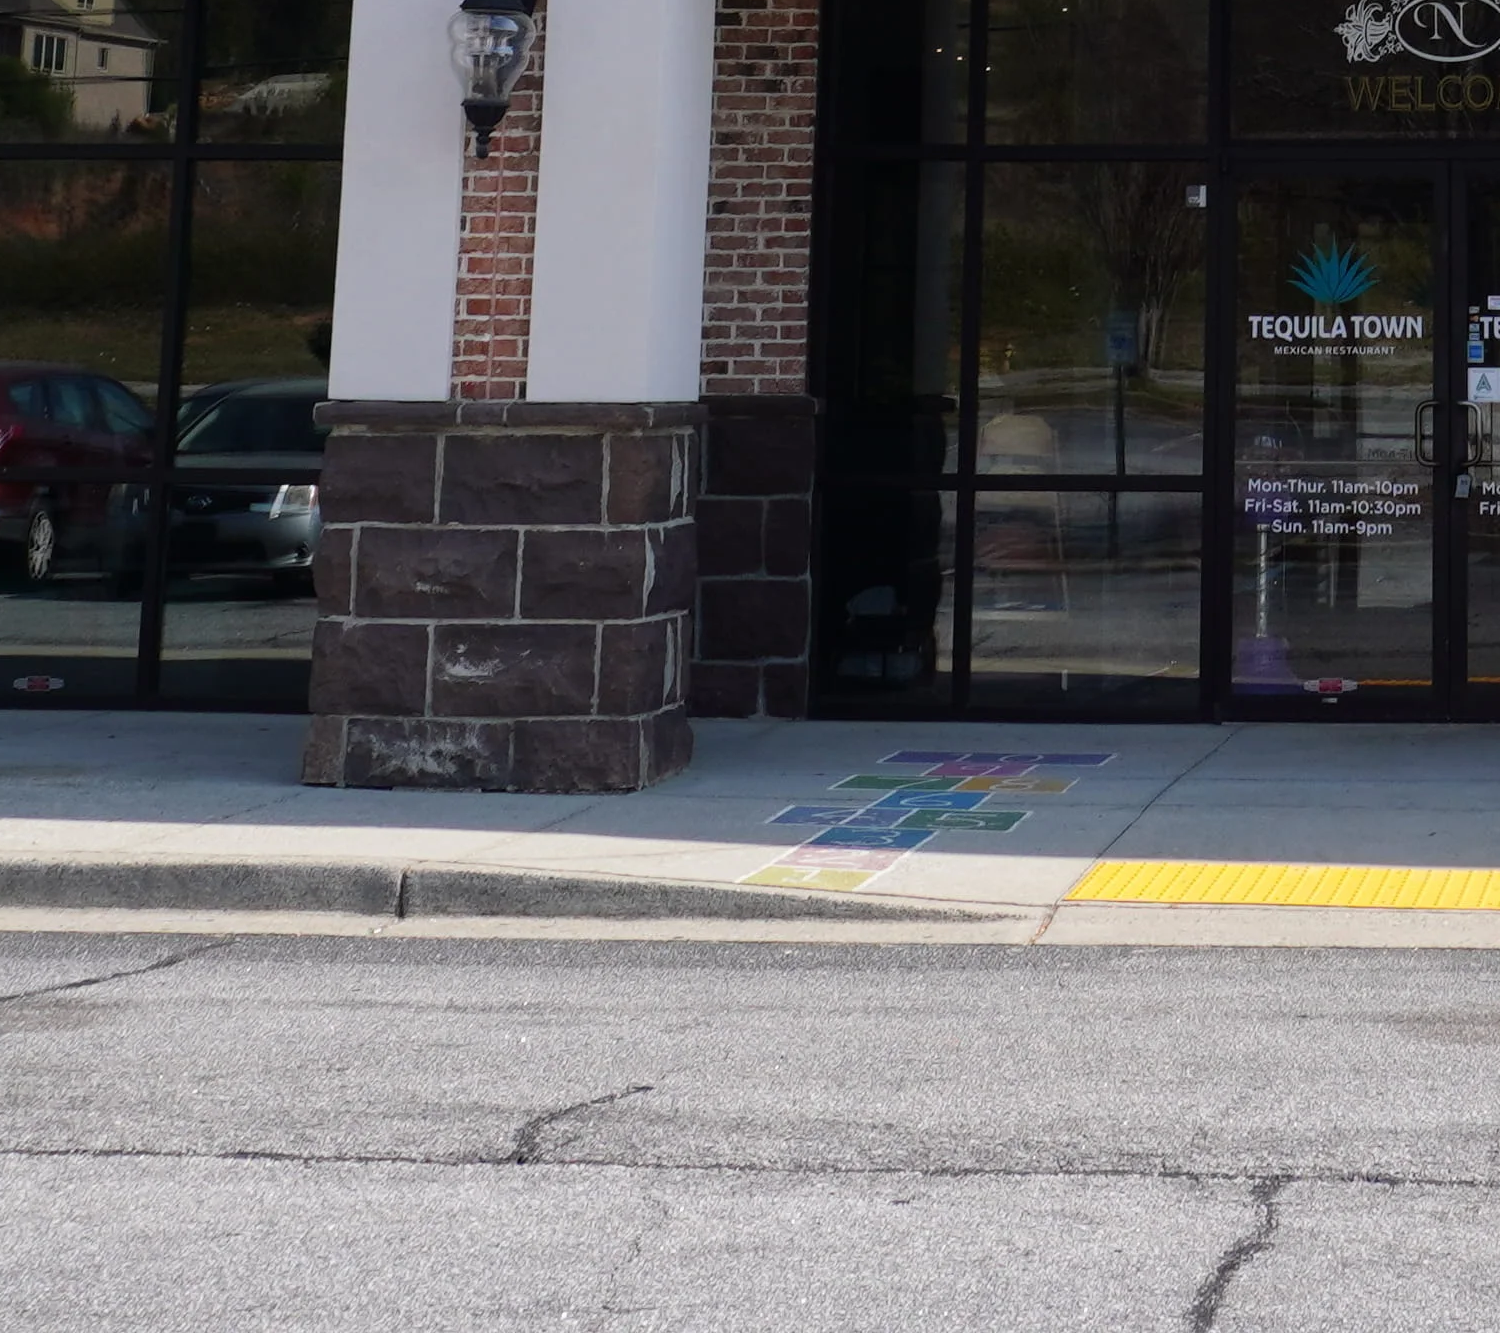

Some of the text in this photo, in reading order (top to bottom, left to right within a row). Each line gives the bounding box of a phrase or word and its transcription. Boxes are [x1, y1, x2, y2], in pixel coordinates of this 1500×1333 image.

[1248, 315, 1424, 342] TEQUILA TOWN
[1274, 345, 1396, 356] MEXICAN RESTAURANT
[1247, 478, 1419, 497] Mon-Thur. 11am-10pm
[1244, 498, 1421, 518] Fri-Sat. 11am-10:30pm
[1272, 519, 1393, 537] Sun. 11am-9pm
